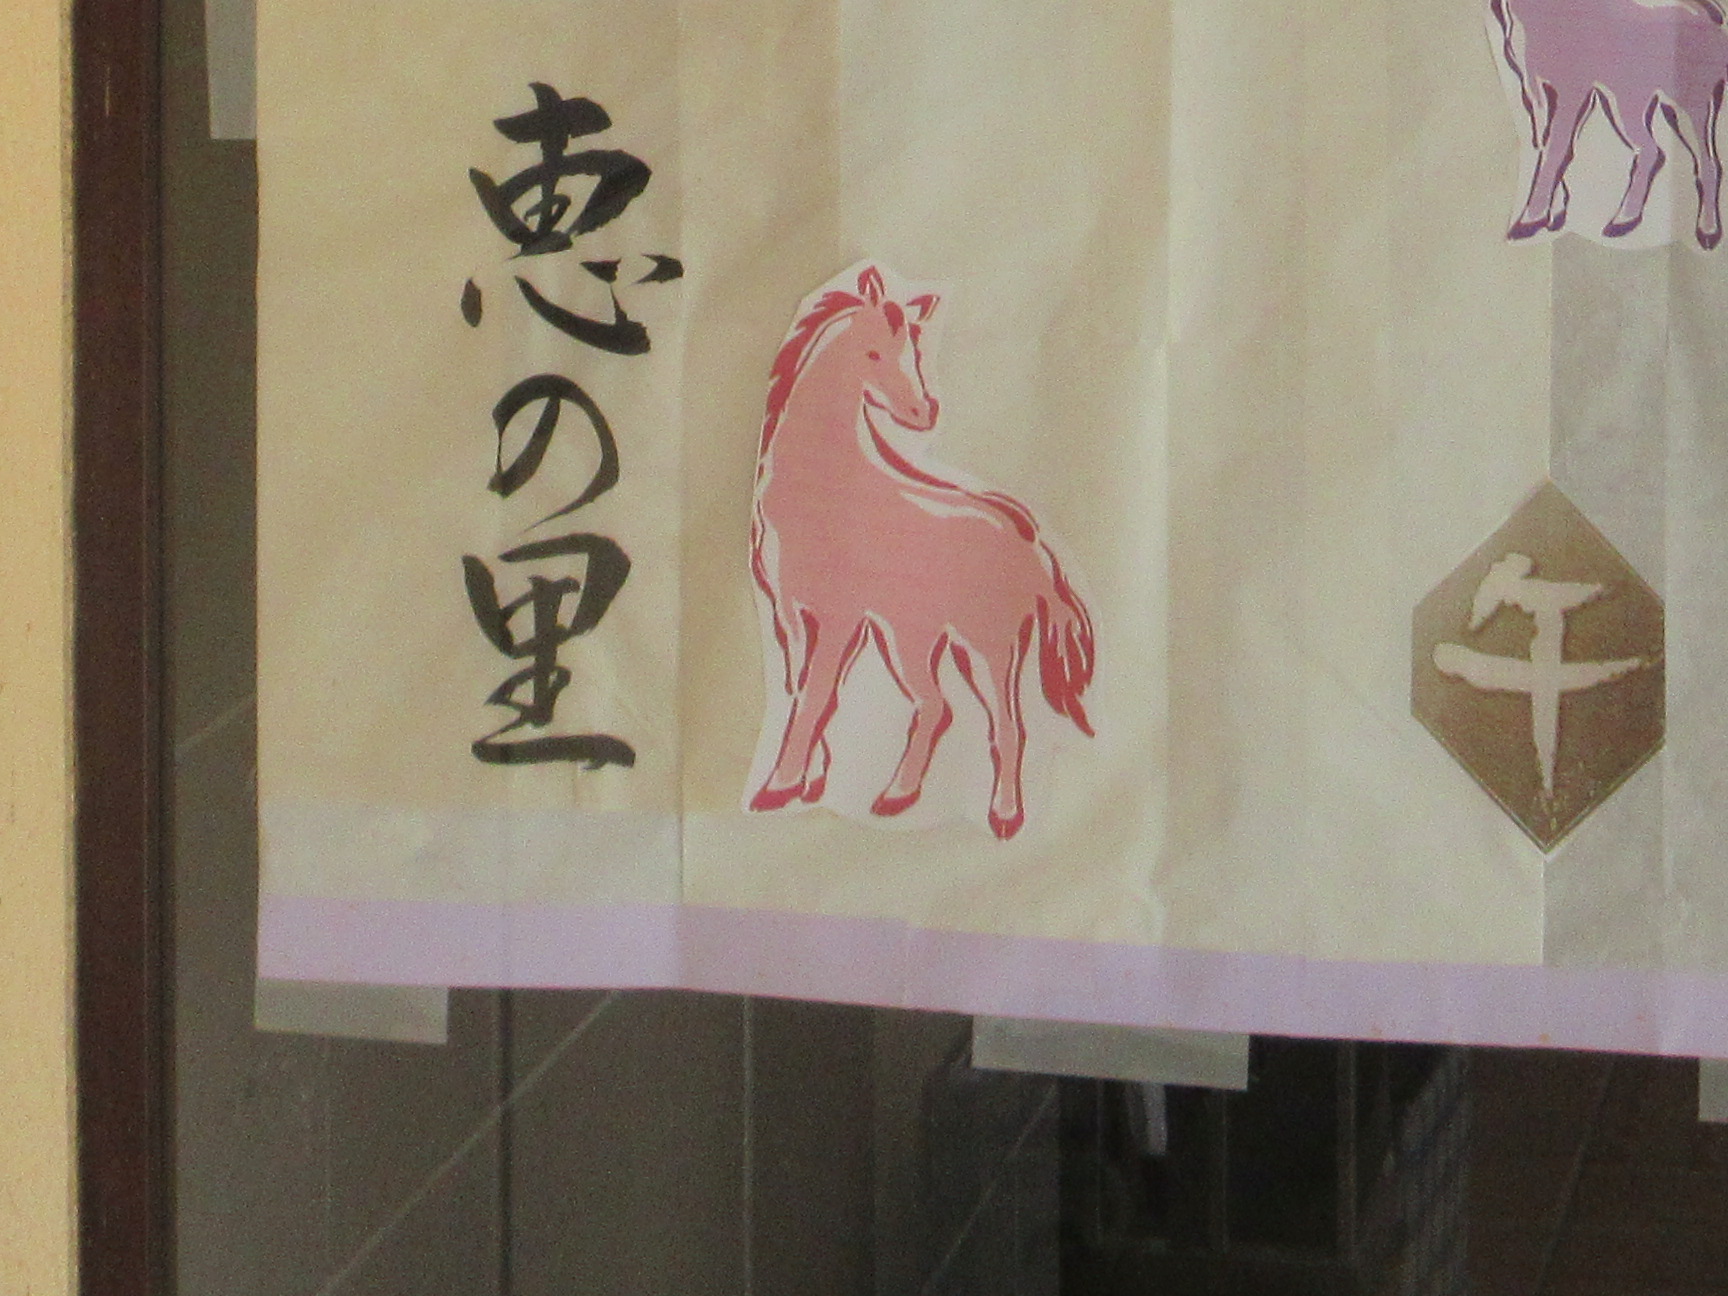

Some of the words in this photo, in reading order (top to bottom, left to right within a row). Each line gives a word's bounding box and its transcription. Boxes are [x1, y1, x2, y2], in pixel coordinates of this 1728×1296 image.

[460, 80, 685, 770] 恵の里
[1430, 551, 1662, 810] 午
